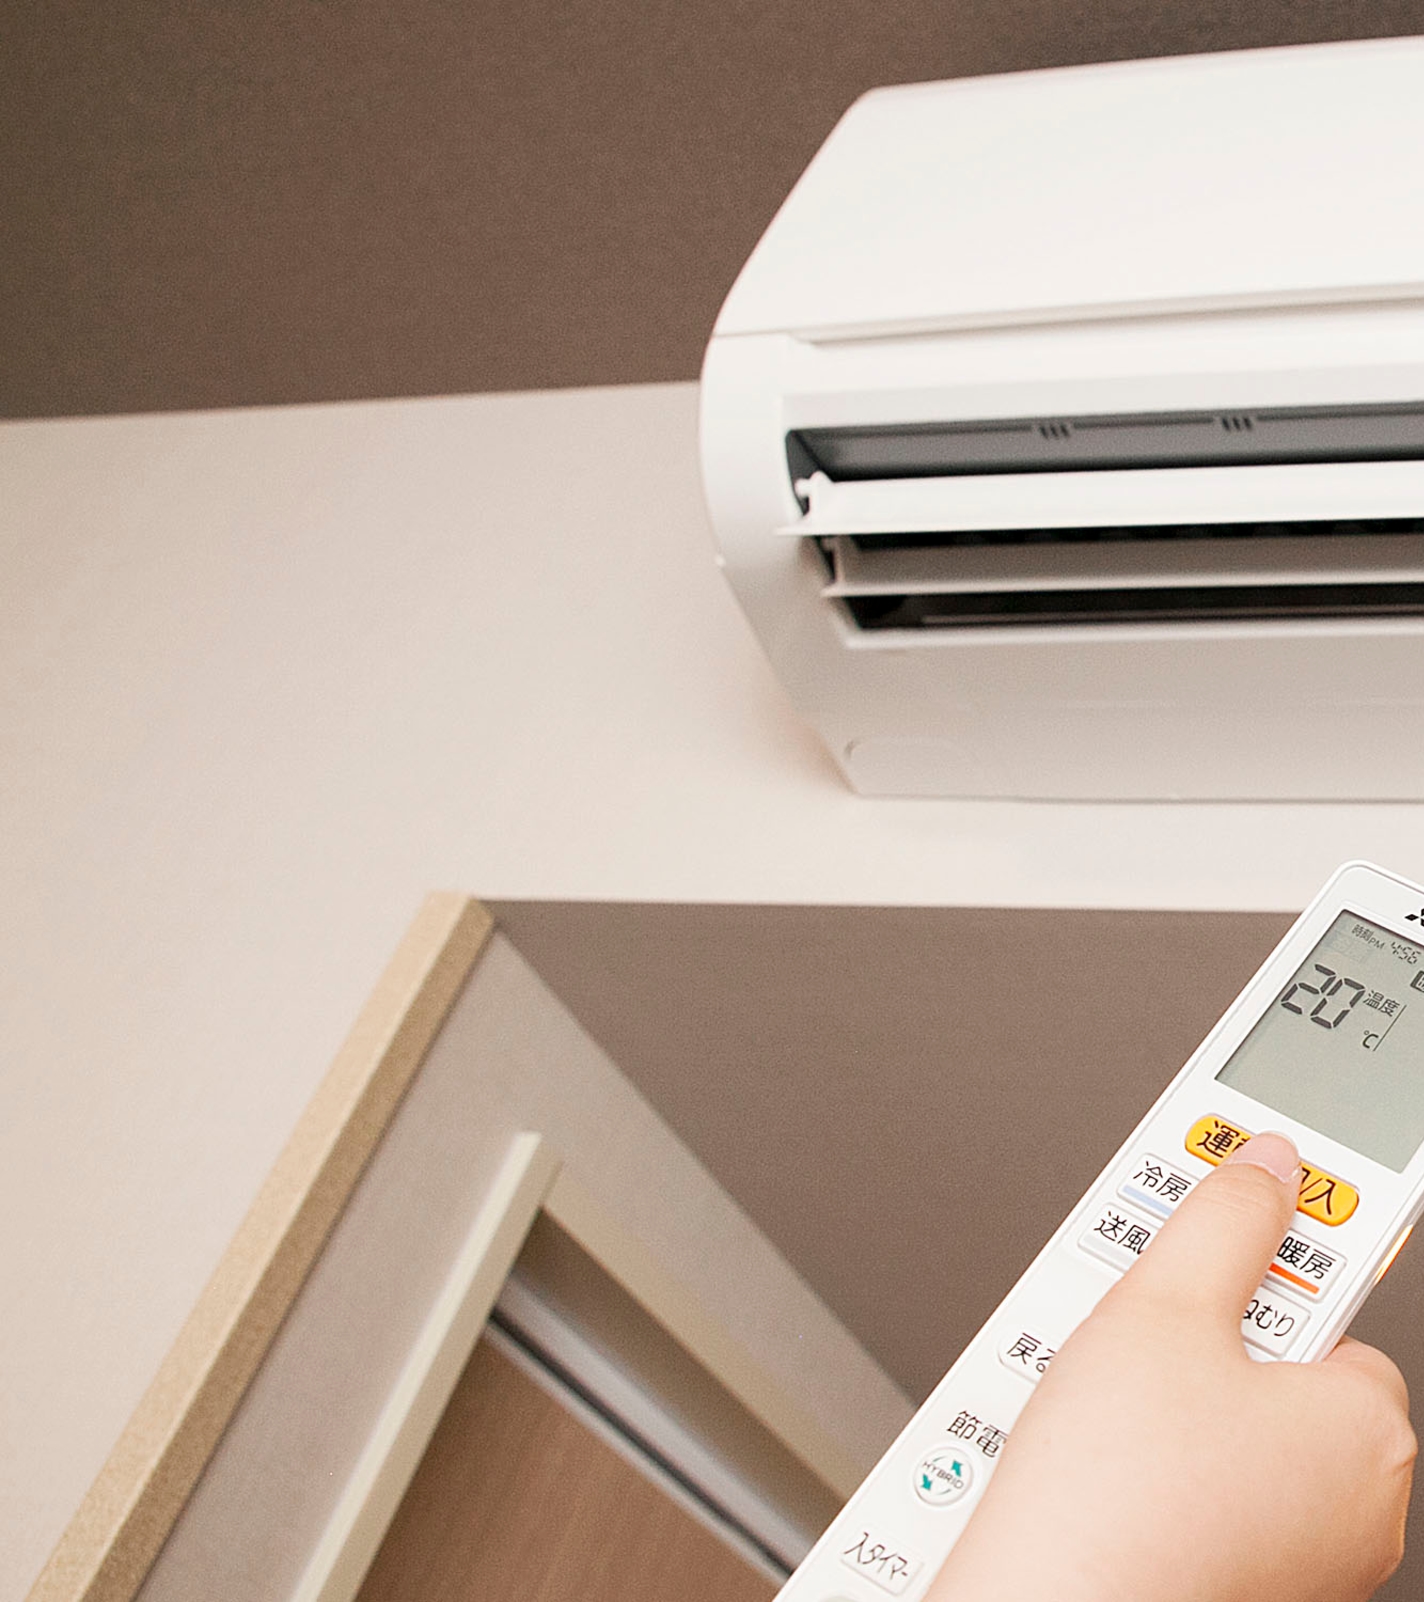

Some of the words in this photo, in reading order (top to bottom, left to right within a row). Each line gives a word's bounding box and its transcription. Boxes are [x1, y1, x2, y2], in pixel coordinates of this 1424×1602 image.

[1368, 936, 1386, 950] PM
[1281, 963, 1366, 1029] 20
[1362, 989, 1400, 1018] 温度
[1132, 1160, 1192, 1203] 冷房
[1094, 1210, 1151, 1255] 送風
[1276, 1236, 1337, 1279] 暖房
[946, 1410, 1009, 1458] 節電
[922, 1460, 965, 1489] HYBRID
[843, 1531, 908, 1580] 入タイマー
